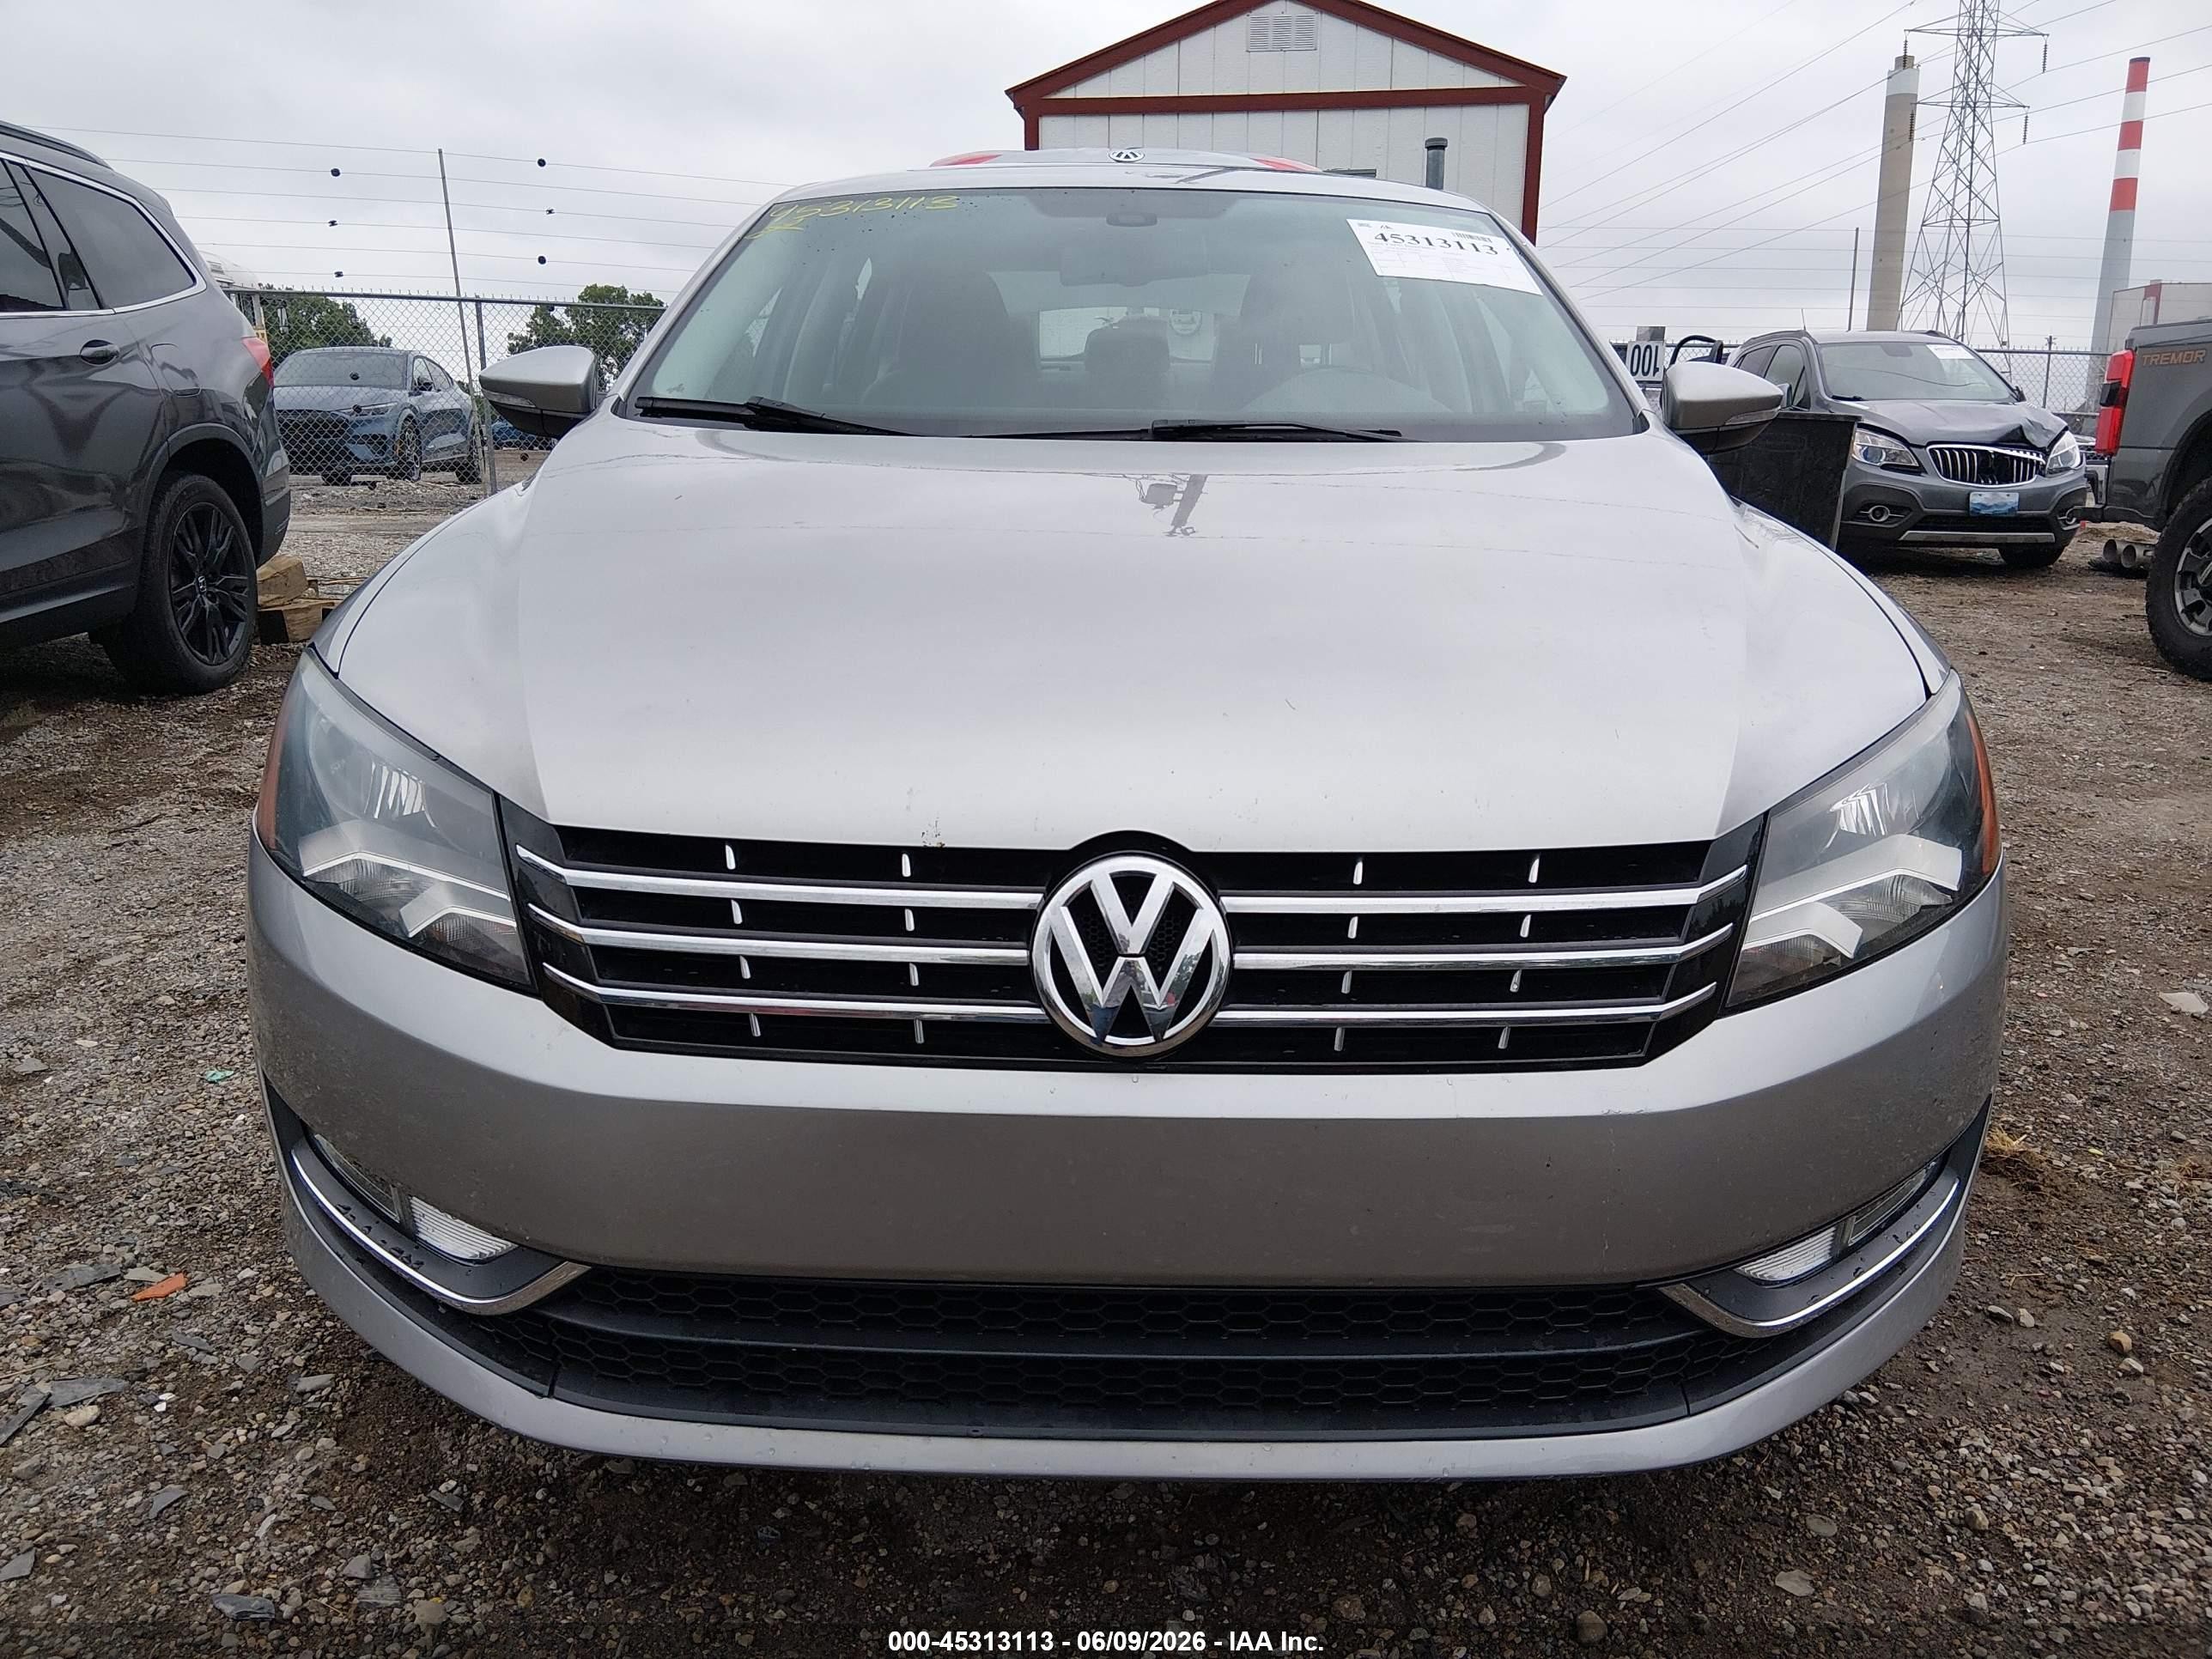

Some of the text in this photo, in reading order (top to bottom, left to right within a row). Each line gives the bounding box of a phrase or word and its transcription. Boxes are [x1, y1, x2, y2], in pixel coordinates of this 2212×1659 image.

[770, 196, 958, 222] 45313113
[1374, 233, 1498, 255] 45313113
[1630, 344, 1659, 377] 100
[2142, 349, 2206, 367] TREMOR
